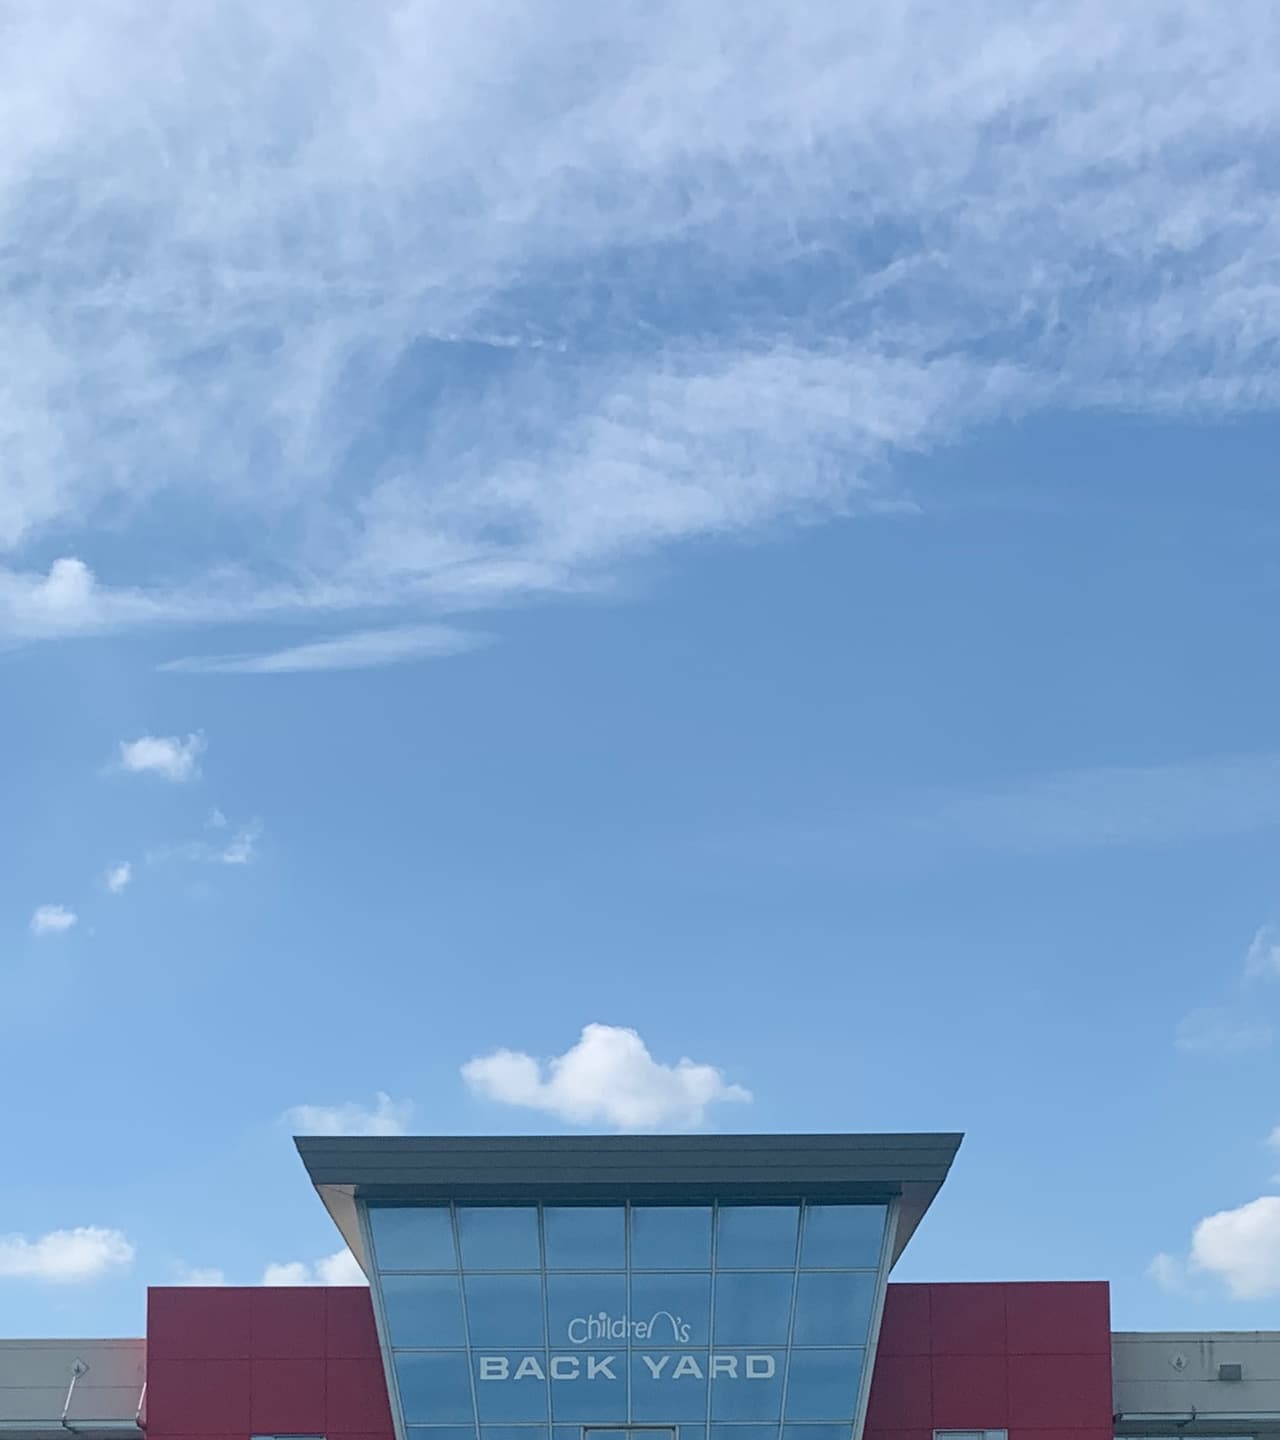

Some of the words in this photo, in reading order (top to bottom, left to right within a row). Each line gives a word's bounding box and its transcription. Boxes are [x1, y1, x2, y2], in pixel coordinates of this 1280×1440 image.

[567, 1310, 691, 1343] Children's
[479, 1355, 617, 1380] BACK
[642, 1354, 776, 1379] YARD
